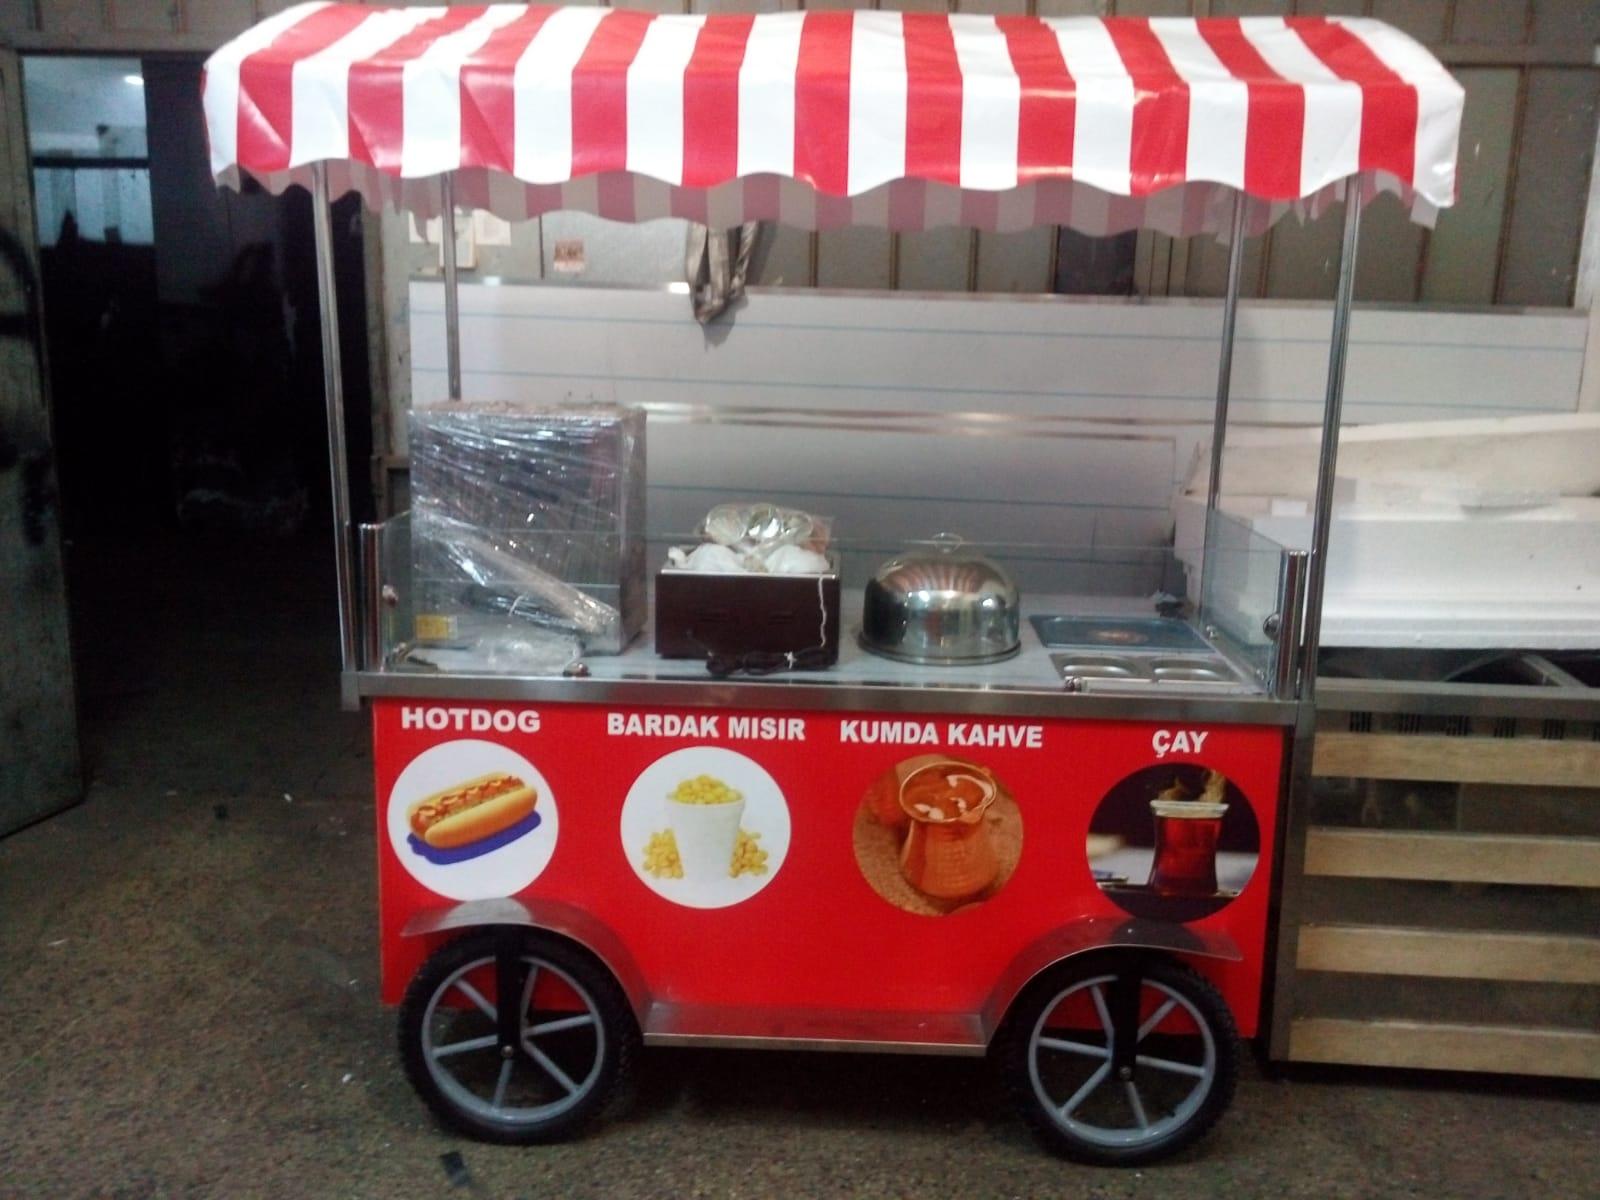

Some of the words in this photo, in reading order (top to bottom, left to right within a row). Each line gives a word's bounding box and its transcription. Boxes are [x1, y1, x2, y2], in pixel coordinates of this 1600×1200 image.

[402, 707, 540, 732] HOTDOG
[608, 713, 719, 737] BARDAK
[729, 717, 805, 740] MISIR
[841, 720, 939, 744] KUMDA
[948, 724, 1042, 747] KAHVE
[1153, 730, 1208, 757] ÇAY
